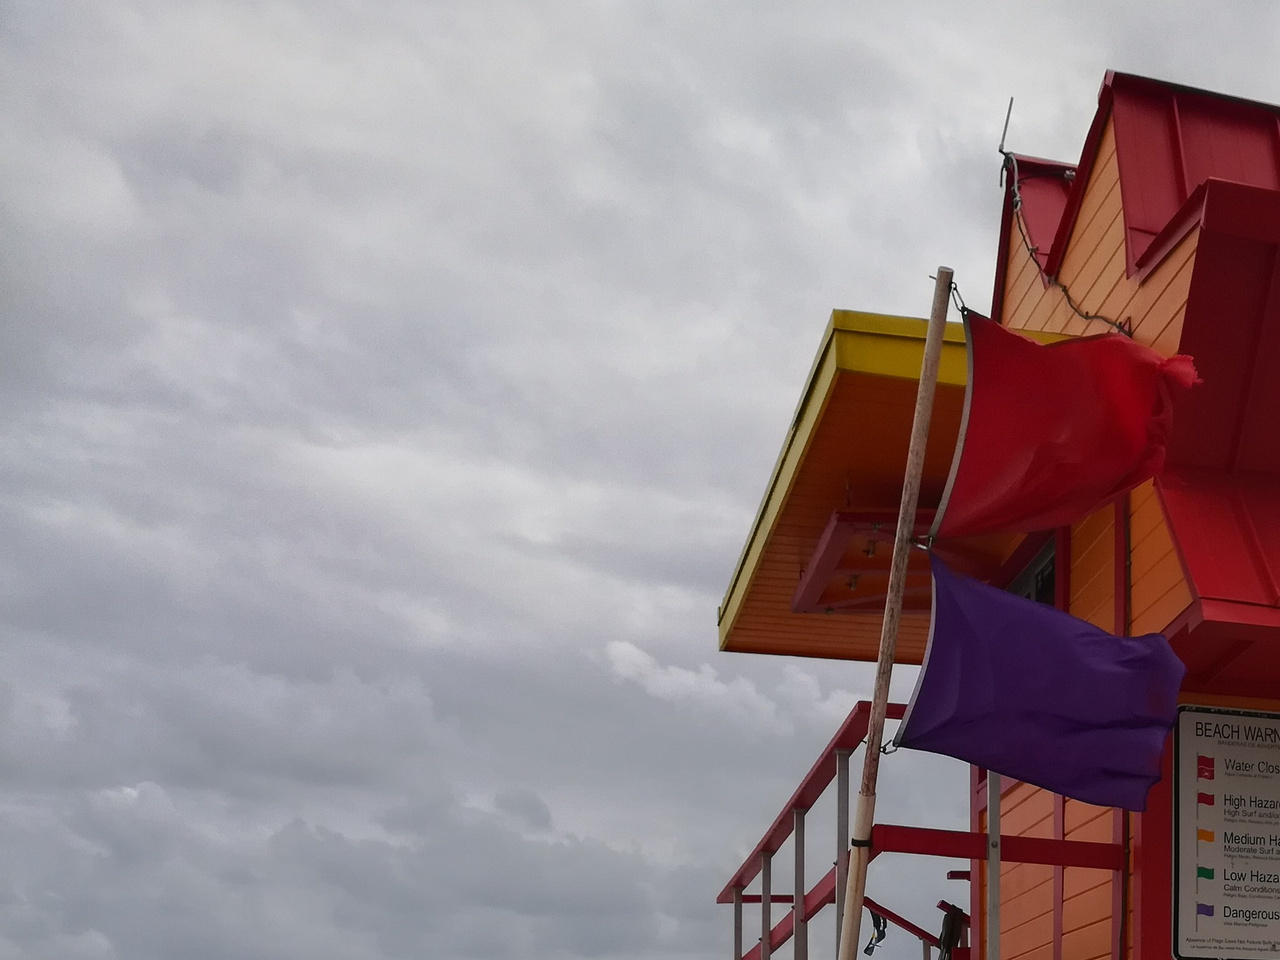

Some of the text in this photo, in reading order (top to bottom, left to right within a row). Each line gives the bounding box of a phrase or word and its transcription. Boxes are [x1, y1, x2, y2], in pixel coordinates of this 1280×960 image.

[1195, 722, 1240, 740] BEACH
[1224, 758, 1254, 772] Water
[1223, 794, 1246, 810] High
[1223, 809, 1240, 817] High
[1241, 809, 1257, 817] Surf
[1223, 832, 1266, 846] Medium
[1223, 845, 1258, 854] Moderate
[1223, 869, 1247, 882] Low
[1223, 884, 1242, 892] Calm
[1223, 905, 1280, 922] Dangerous
